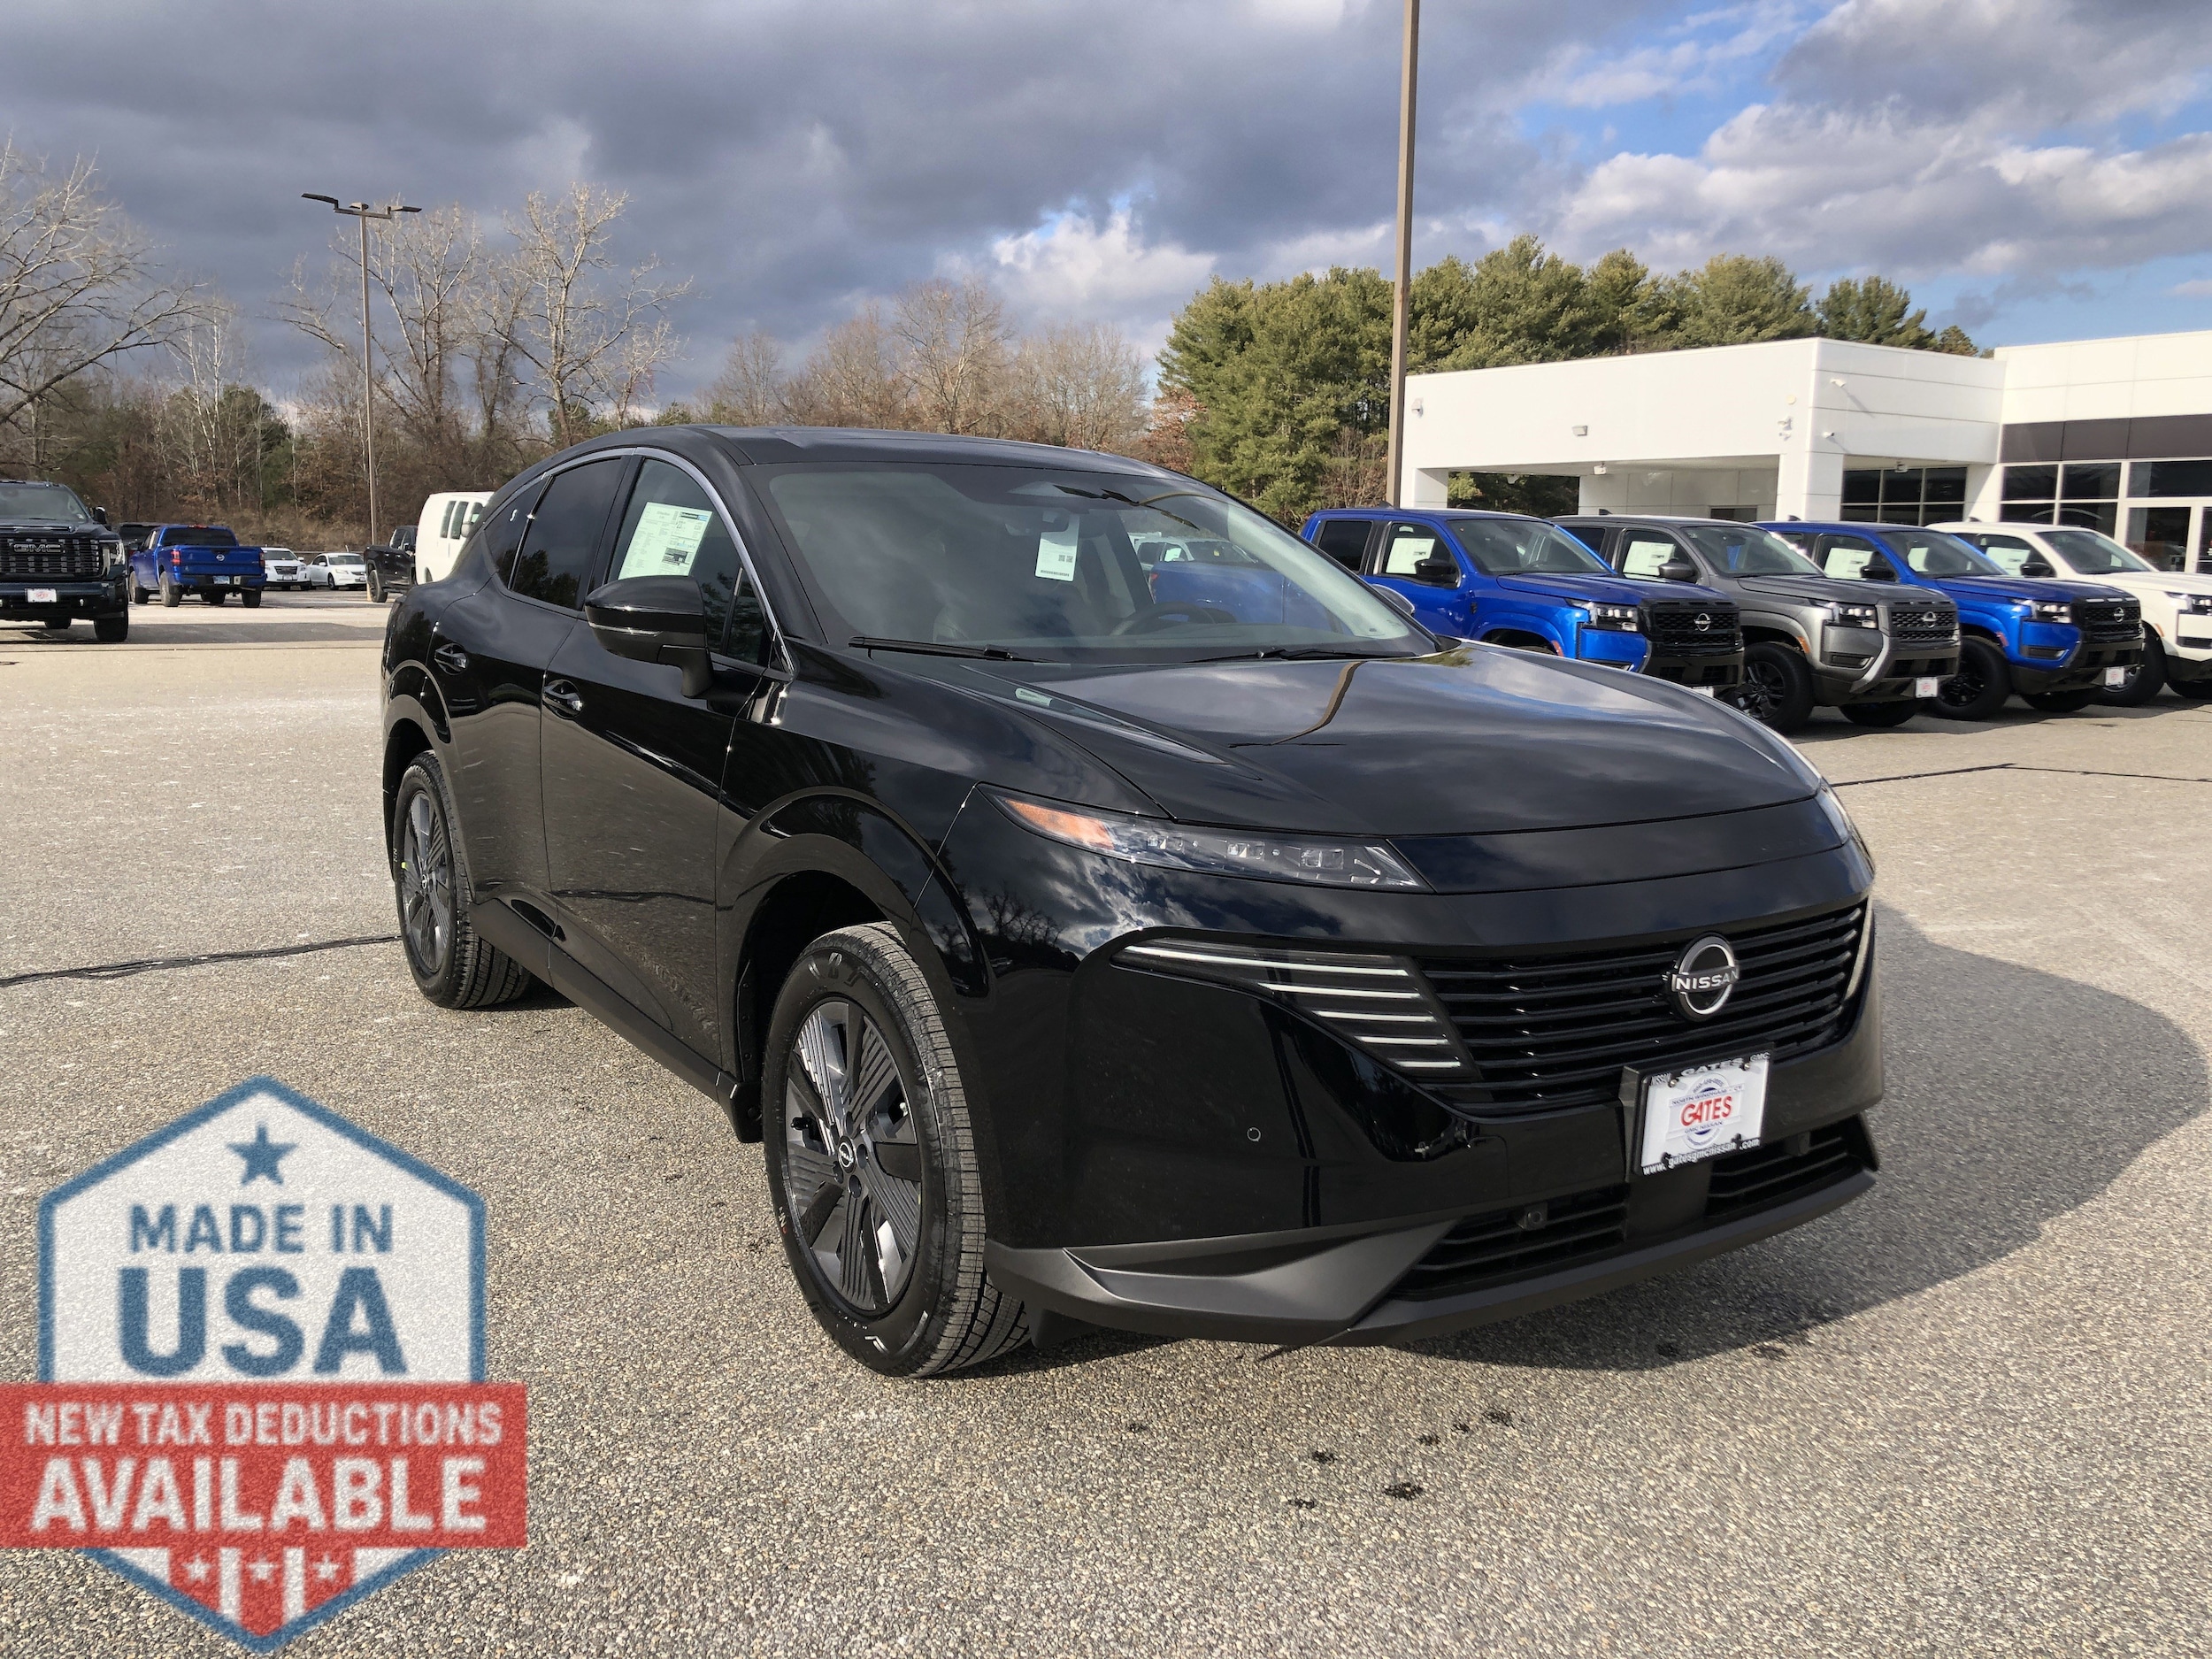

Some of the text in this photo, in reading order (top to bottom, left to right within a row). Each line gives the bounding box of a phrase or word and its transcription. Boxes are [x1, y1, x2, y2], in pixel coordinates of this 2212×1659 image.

[14, 543, 61, 553] GMC
[1675, 969, 1740, 990] NISSAN
[1680, 1051, 1770, 1077] GATES GMC
[1680, 1095, 1733, 1126] GATES
